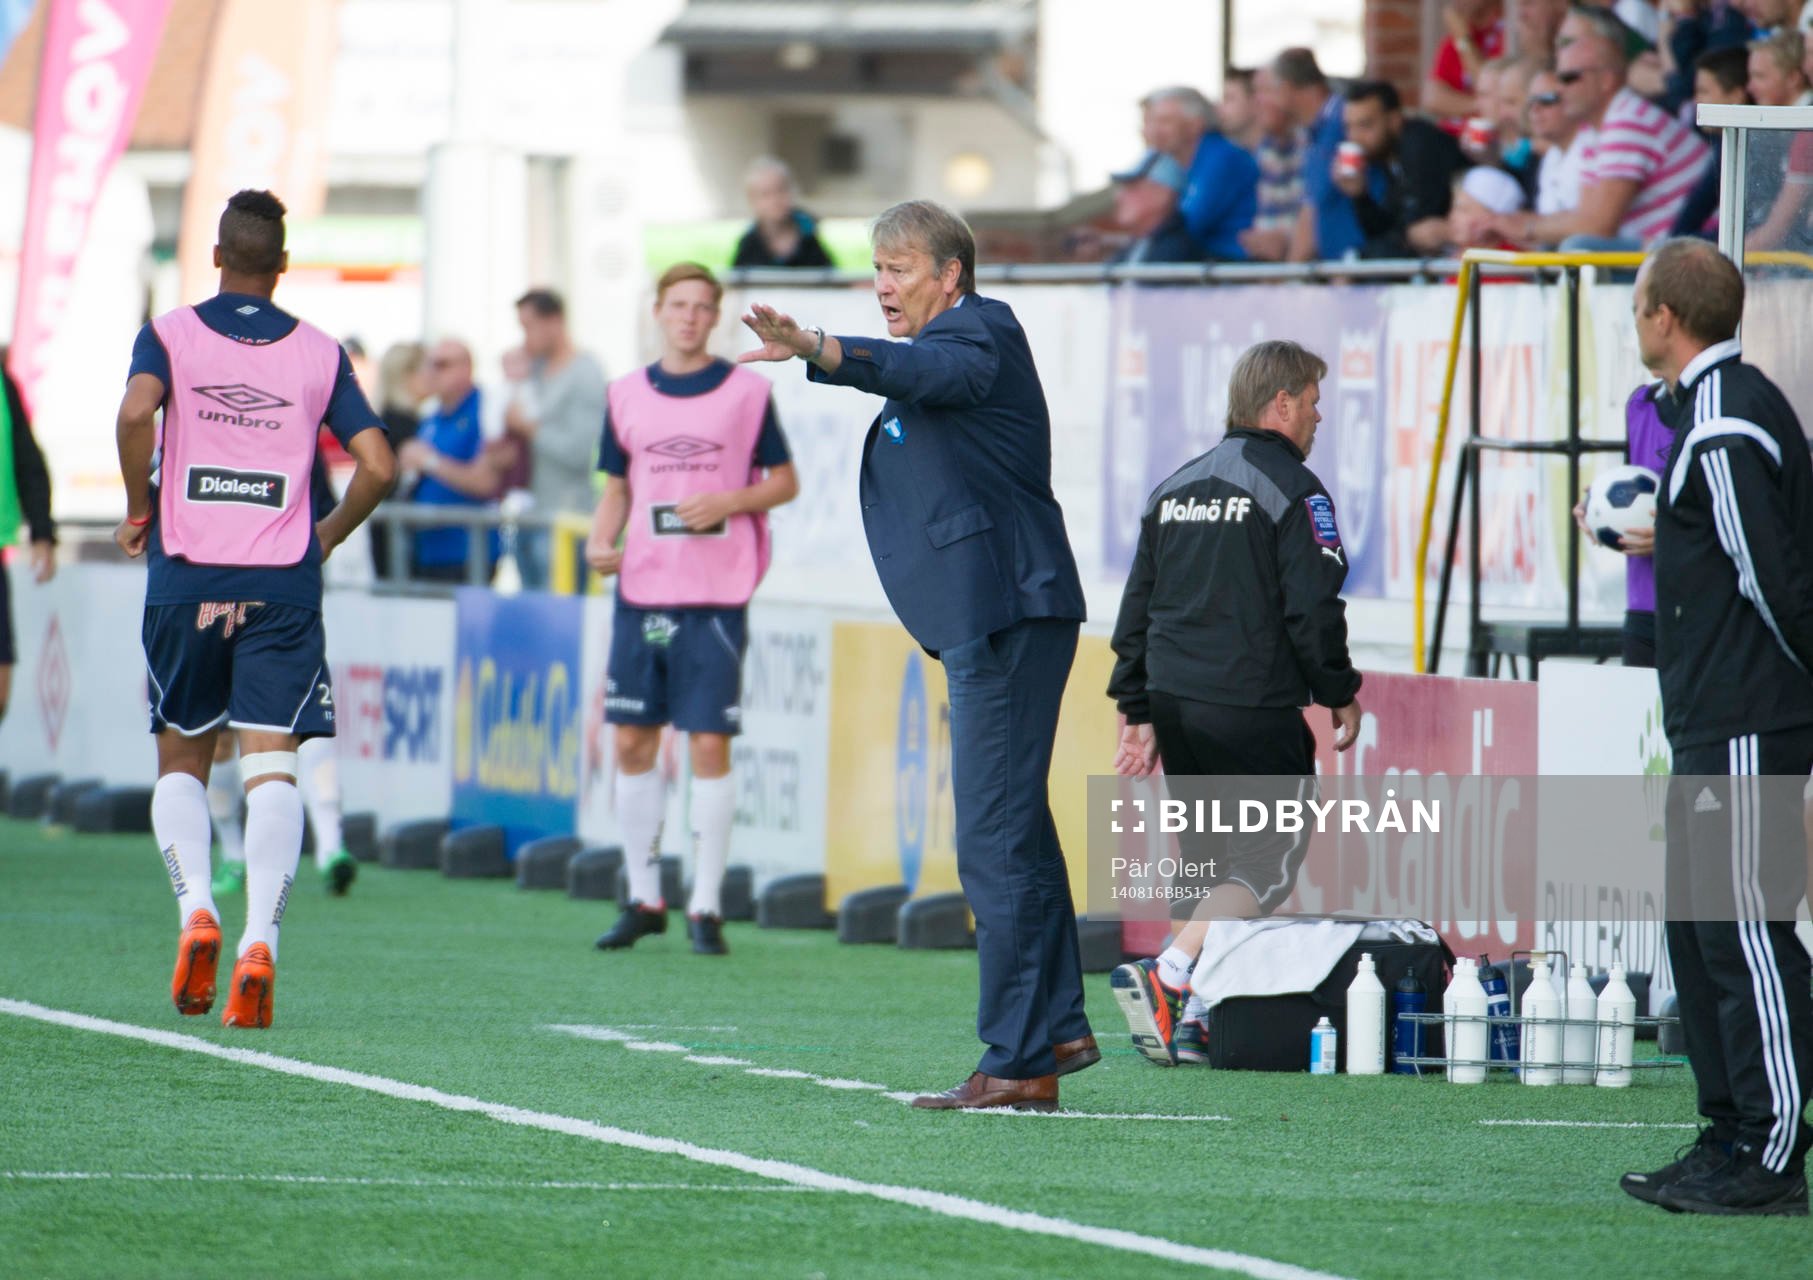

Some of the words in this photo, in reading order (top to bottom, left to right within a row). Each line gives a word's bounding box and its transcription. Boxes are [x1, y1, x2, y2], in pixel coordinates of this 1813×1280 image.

[198, 410, 281, 430] umbro
[650, 462, 719, 474] umbro
[199, 476, 272, 497] Dialect
[1160, 497, 1221, 525] Malmö
[1224, 497, 1251, 522] FF
[1353, 708, 1521, 946] Scandic
